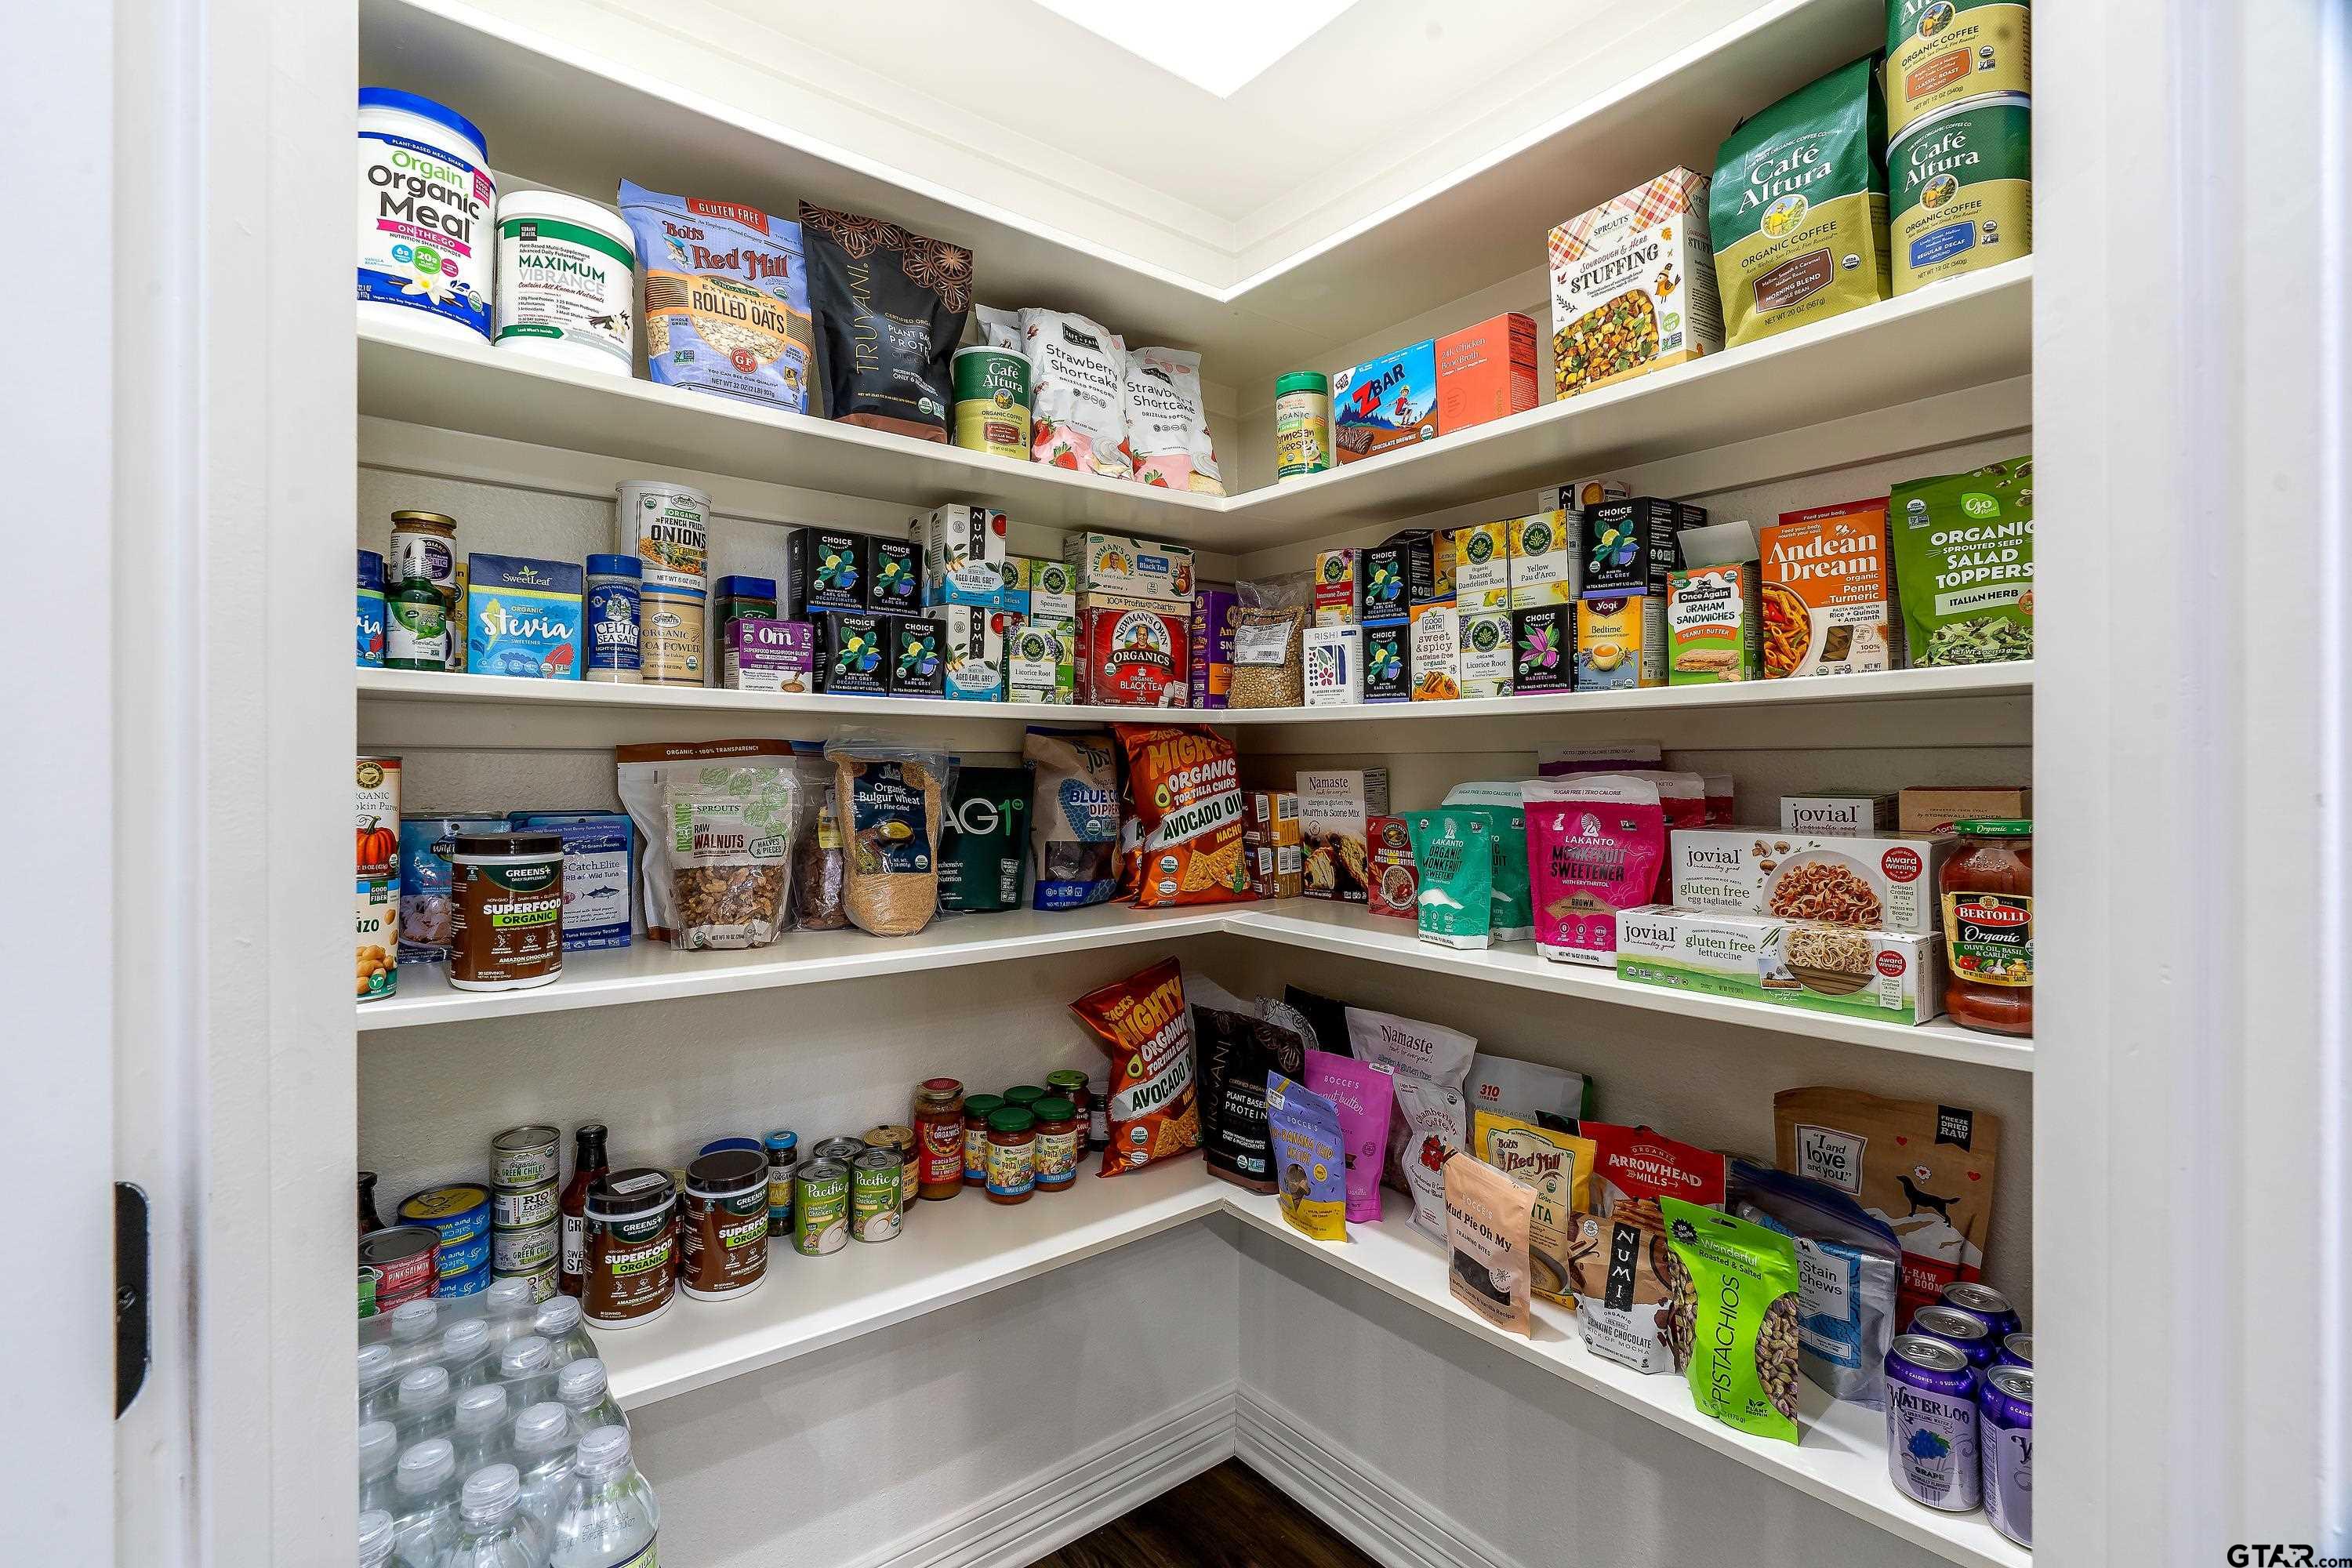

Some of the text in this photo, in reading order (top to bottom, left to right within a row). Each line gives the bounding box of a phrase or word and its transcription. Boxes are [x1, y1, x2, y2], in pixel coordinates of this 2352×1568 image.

[1901, 25, 1979, 66] ORGANIC COFFEE
[1911, 132, 1966, 166] Café
[391, 150, 463, 187] Orgain
[1751, 143, 1820, 185] Café
[1904, 151, 1980, 193] Altura
[368, 165, 480, 220] Organic
[1737, 162, 1832, 216] Altura
[380, 191, 474, 243] Meal
[699, 202, 759, 226] GLUTEN FREE
[1905, 201, 1982, 234] ORGANIC COFFEE
[662, 220, 704, 241] Bob's
[1594, 215, 1629, 237] SPROUTS
[1741, 220, 1837, 268] ORGANIC COFFEE
[1917, 239, 1966, 260] REGULAR DECAF
[518, 255, 605, 284] MAXIMUM
[691, 245, 789, 281] Red Mill
[1570, 243, 1659, 295] STUFFING
[519, 268, 604, 296] VIBRANCE
[1766, 273, 1820, 303] MORNING BLEND
[693, 290, 784, 335] ROLLED OATS
[855, 263, 879, 375] TRUVANI
[989, 362, 1019, 380] Café
[1046, 343, 1118, 383] Strawberry
[982, 373, 1023, 394] Altura
[1051, 359, 1118, 393] Shortcake
[1127, 382, 1192, 405] Strawberry
[1133, 395, 1195, 415] Shortcake
[1598, 506, 1632, 517] CHOICE
[651, 524, 706, 549] ONIONS
[822, 535, 852, 546] CHOICE
[1767, 533, 1878, 565] Andean
[1943, 539, 2023, 554] SPROUTED SEED
[1139, 562, 1154, 571] Black
[1526, 563, 1549, 572] Yellow
[1947, 549, 2019, 570] SALAD
[1780, 555, 1878, 583] Dream
[1846, 572, 1879, 583] organic
[1935, 562, 2034, 590] TOPPERS
[502, 573, 553, 586] SweetLeaf
[1458, 577, 1504, 590] Dandelion Root
[1843, 583, 1879, 593] Penne
[1040, 599, 1068, 610] Spearmint
[1680, 590, 1729, 601] Once Again
[1830, 591, 1879, 604] Turmeric
[1949, 590, 2019, 607] ITALIAN HERB
[1595, 601, 1618, 612] yogi
[1686, 602, 1725, 614] GRAHAM
[480, 608, 574, 640] Stevia
[844, 617, 875, 627] CHOICE
[1676, 612, 1735, 625] SANDWICHES
[597, 633, 636, 645] SEA SALT
[759, 627, 793, 645] Om
[1314, 631, 1339, 641] RISHI
[1418, 632, 1450, 644] sweet
[1591, 626, 1621, 634] Bedtime
[1682, 629, 1704, 638] PEANUT
[1113, 652, 1170, 666] ORGANICS
[1120, 681, 1163, 691] BLACK TEA
[716, 746, 759, 754] TRANSPARENCY
[1168, 757, 1237, 790] ORGANIC
[874, 782, 906, 795] Organic
[1174, 778, 1236, 805] TORTILLA CHIPS
[1308, 777, 1348, 790] Namaste
[859, 792, 920, 806] Bulgur Wheat
[1163, 799, 1221, 842] AVOCADO
[1791, 802, 1860, 829] jovial
[694, 824, 710, 833] RAW
[1976, 825, 2007, 834] Organic
[694, 834, 744, 849] WALNUTS
[758, 839, 780, 848] HALVES
[1432, 838, 1464, 848] LAKANTO
[1565, 836, 1614, 847] LAKANTO
[1686, 845, 1743, 866] jovial
[1885, 855, 1918, 865] Award
[1549, 862, 1624, 882] SWEETENER
[1885, 863, 1918, 873] Winning
[1680, 882, 1750, 898] gluten free
[483, 898, 562, 916] SUPERFOOD
[1687, 895, 1742, 907] egg tagliatelle
[502, 911, 553, 924] ORGANIC
[1960, 907, 2024, 921] BERTOLLI
[1624, 920, 1678, 942] jovial
[1965, 926, 2020, 944] Organic
[1685, 935, 1756, 953] gluten free
[499, 952, 554, 964] AMAZON CHOCOLATE
[1697, 947, 1742, 961] fettuccine
[1109, 976, 1184, 1051] MIGHTY
[1380, 1025, 1434, 1054] Namaste
[1131, 1061, 1186, 1112] AVOCADO
[1323, 1075, 1360, 1089] BOCCE'S
[1226, 1091, 1267, 1109] PLANT BASED
[1225, 1102, 1268, 1120] PROTEIN
[1940, 1115, 1969, 1125] FREEZE
[1415, 1107, 1457, 1137] Chamberlain
[1941, 1121, 1969, 1131] DRIED
[934, 1129, 960, 1139] ORGANICS
[1940, 1127, 1969, 1140] RAW
[1507, 1152, 1562, 1174] Red Mill
[1806, 1141, 1846, 1169] love
[1608, 1152, 1702, 1188] ARROWHEAD
[1636, 1171, 1668, 1187] MILLS
[855, 1172, 891, 1187] Pacific
[807, 1181, 844, 1197] Pacific
[604, 1239, 673, 1265] SUPERFOOD
[1701, 1238, 1759, 1267] Wonderful
[619, 1255, 664, 1273] ORGANIC
[1611, 1229, 1635, 1299] NUMI
[1803, 1261, 1838, 1283] Stain
[1800, 1272, 1842, 1296] Chews
[1613, 1330, 1652, 1349] CHOCOLATE
[1711, 1273, 1740, 1405] PISTACHIOS
[1887, 1383, 1969, 1424] WATERLOO
